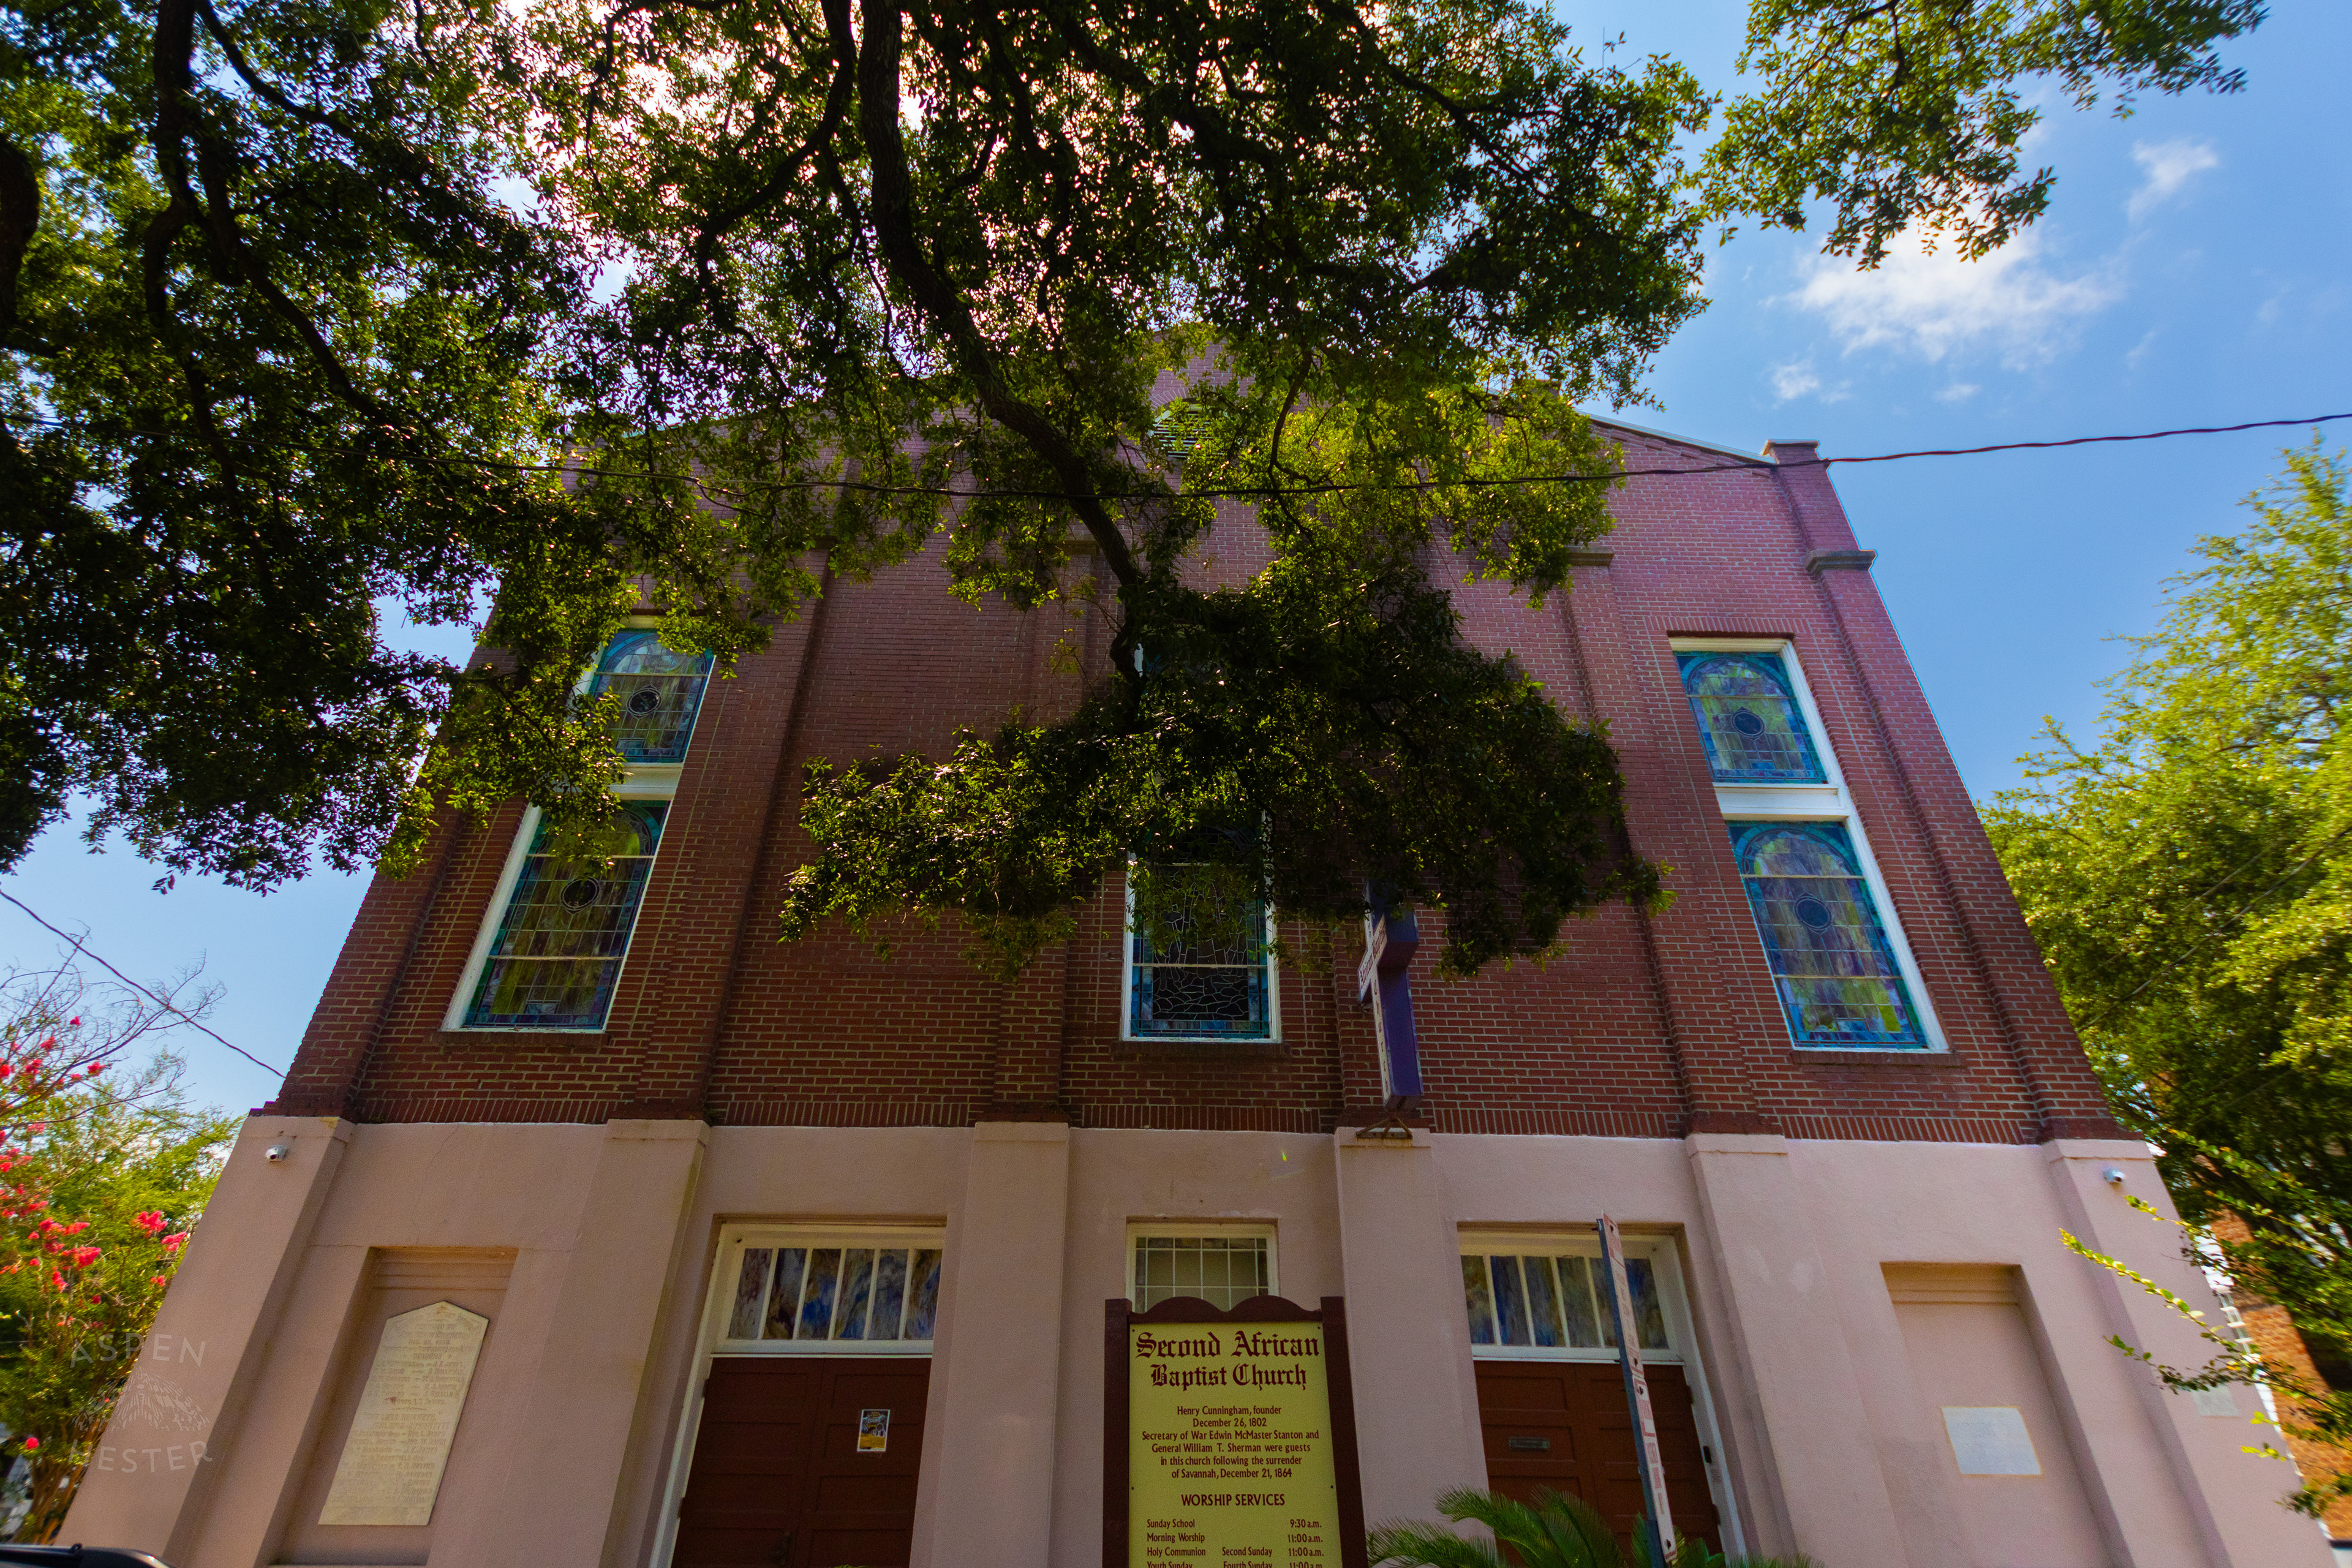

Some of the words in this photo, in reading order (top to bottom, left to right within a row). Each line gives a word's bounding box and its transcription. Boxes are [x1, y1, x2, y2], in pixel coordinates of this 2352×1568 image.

[1136, 1332, 1221, 1359] Second
[1231, 1330, 1319, 1357] African
[1150, 1363, 1227, 1391] Baptist
[1232, 1363, 1307, 1390] Church
[1177, 1406, 1199, 1416] Henry
[1202, 1406, 1252, 1415] Cunningham,
[1253, 1406, 1281, 1414] founder
[1193, 1419, 1231, 1427] December
[1234, 1418, 1246, 1428] 26,
[1249, 1418, 1267, 1427] 1802
[1142, 1431, 1177, 1441] Secretary
[1180, 1431, 1188, 1439] of
[1191, 1431, 1207, 1439] War
[1209, 1431, 1232, 1439] Edwin
[1235, 1431, 1272, 1439] McMaster
[1274, 1430, 1303, 1439] Stanton
[1305, 1430, 1319, 1439] and
[1152, 1444, 1181, 1452] General
[1183, 1443, 1213, 1452] William
[1217, 1443, 1224, 1452] T.
[1227, 1443, 1261, 1452] Sherman
[1286, 1444, 1310, 1453] guests
[1161, 1457, 1167, 1465] in
[1170, 1457, 1183, 1465] this
[1185, 1457, 1210, 1465] church
[1213, 1456, 1248, 1466] following
[1251, 1456, 1264, 1464] the
[1265, 1456, 1302, 1464] surrender
[1172, 1469, 1180, 1478] of
[1182, 1469, 1219, 1479] Savannah,
[1220, 1469, 1259, 1478] December
[1262, 1469, 1272, 1479] 21,
[1274, 1469, 1292, 1477] 1864
[1181, 1494, 1232, 1506] WORSHIP
[1235, 1493, 1285, 1506] SERVICES
[1147, 1519, 1170, 1529] Sunday
[1172, 1519, 1195, 1528] School
[1290, 1519, 1306, 1528] 9:30
[1147, 1533, 1175, 1543] Morning
[1178, 1532, 1205, 1543] Worship
[1147, 1547, 1163, 1558] Holy
[1164, 1547, 1206, 1556] Communion
[1222, 1547, 1246, 1556] Second
[1248, 1547, 1273, 1557] Sunday
[1288, 1548, 1308, 1556] 11:00
